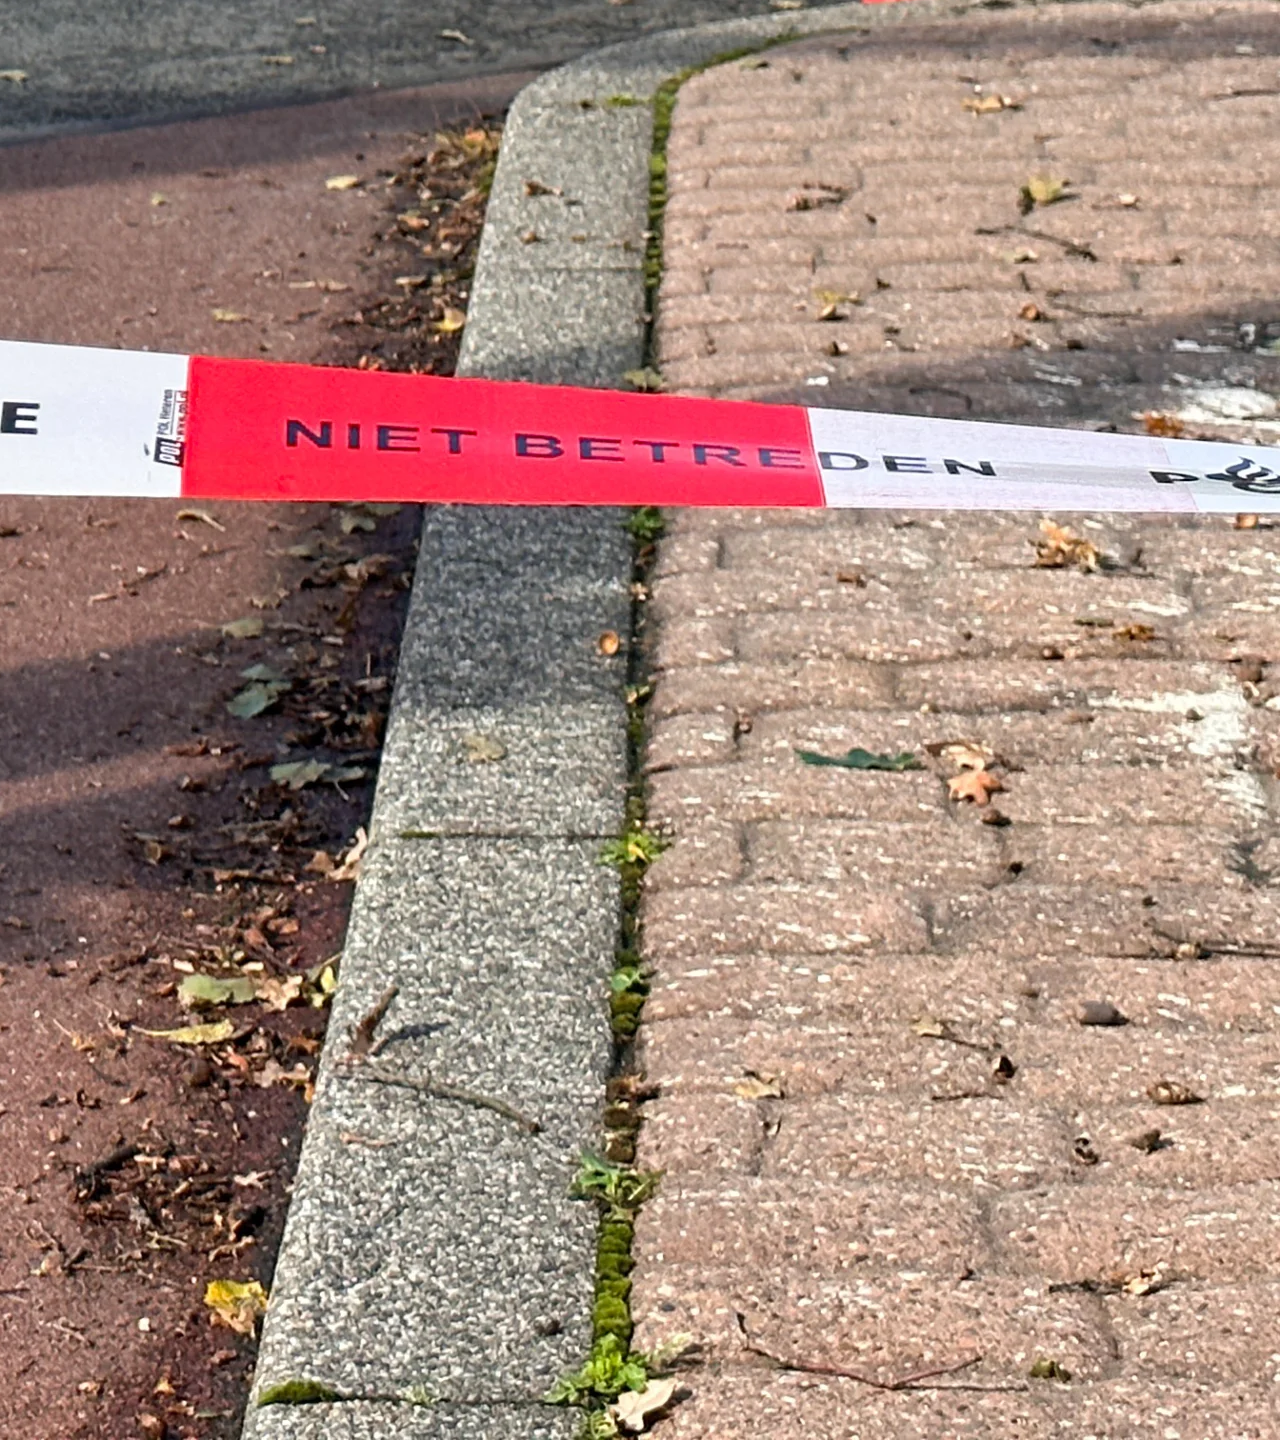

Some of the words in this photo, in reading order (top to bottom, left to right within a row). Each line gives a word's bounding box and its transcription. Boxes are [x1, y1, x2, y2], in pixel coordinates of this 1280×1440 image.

[156, 438, 183, 466] POL
[285, 418, 479, 456] NIET
[515, 432, 998, 478] BETREDEN
